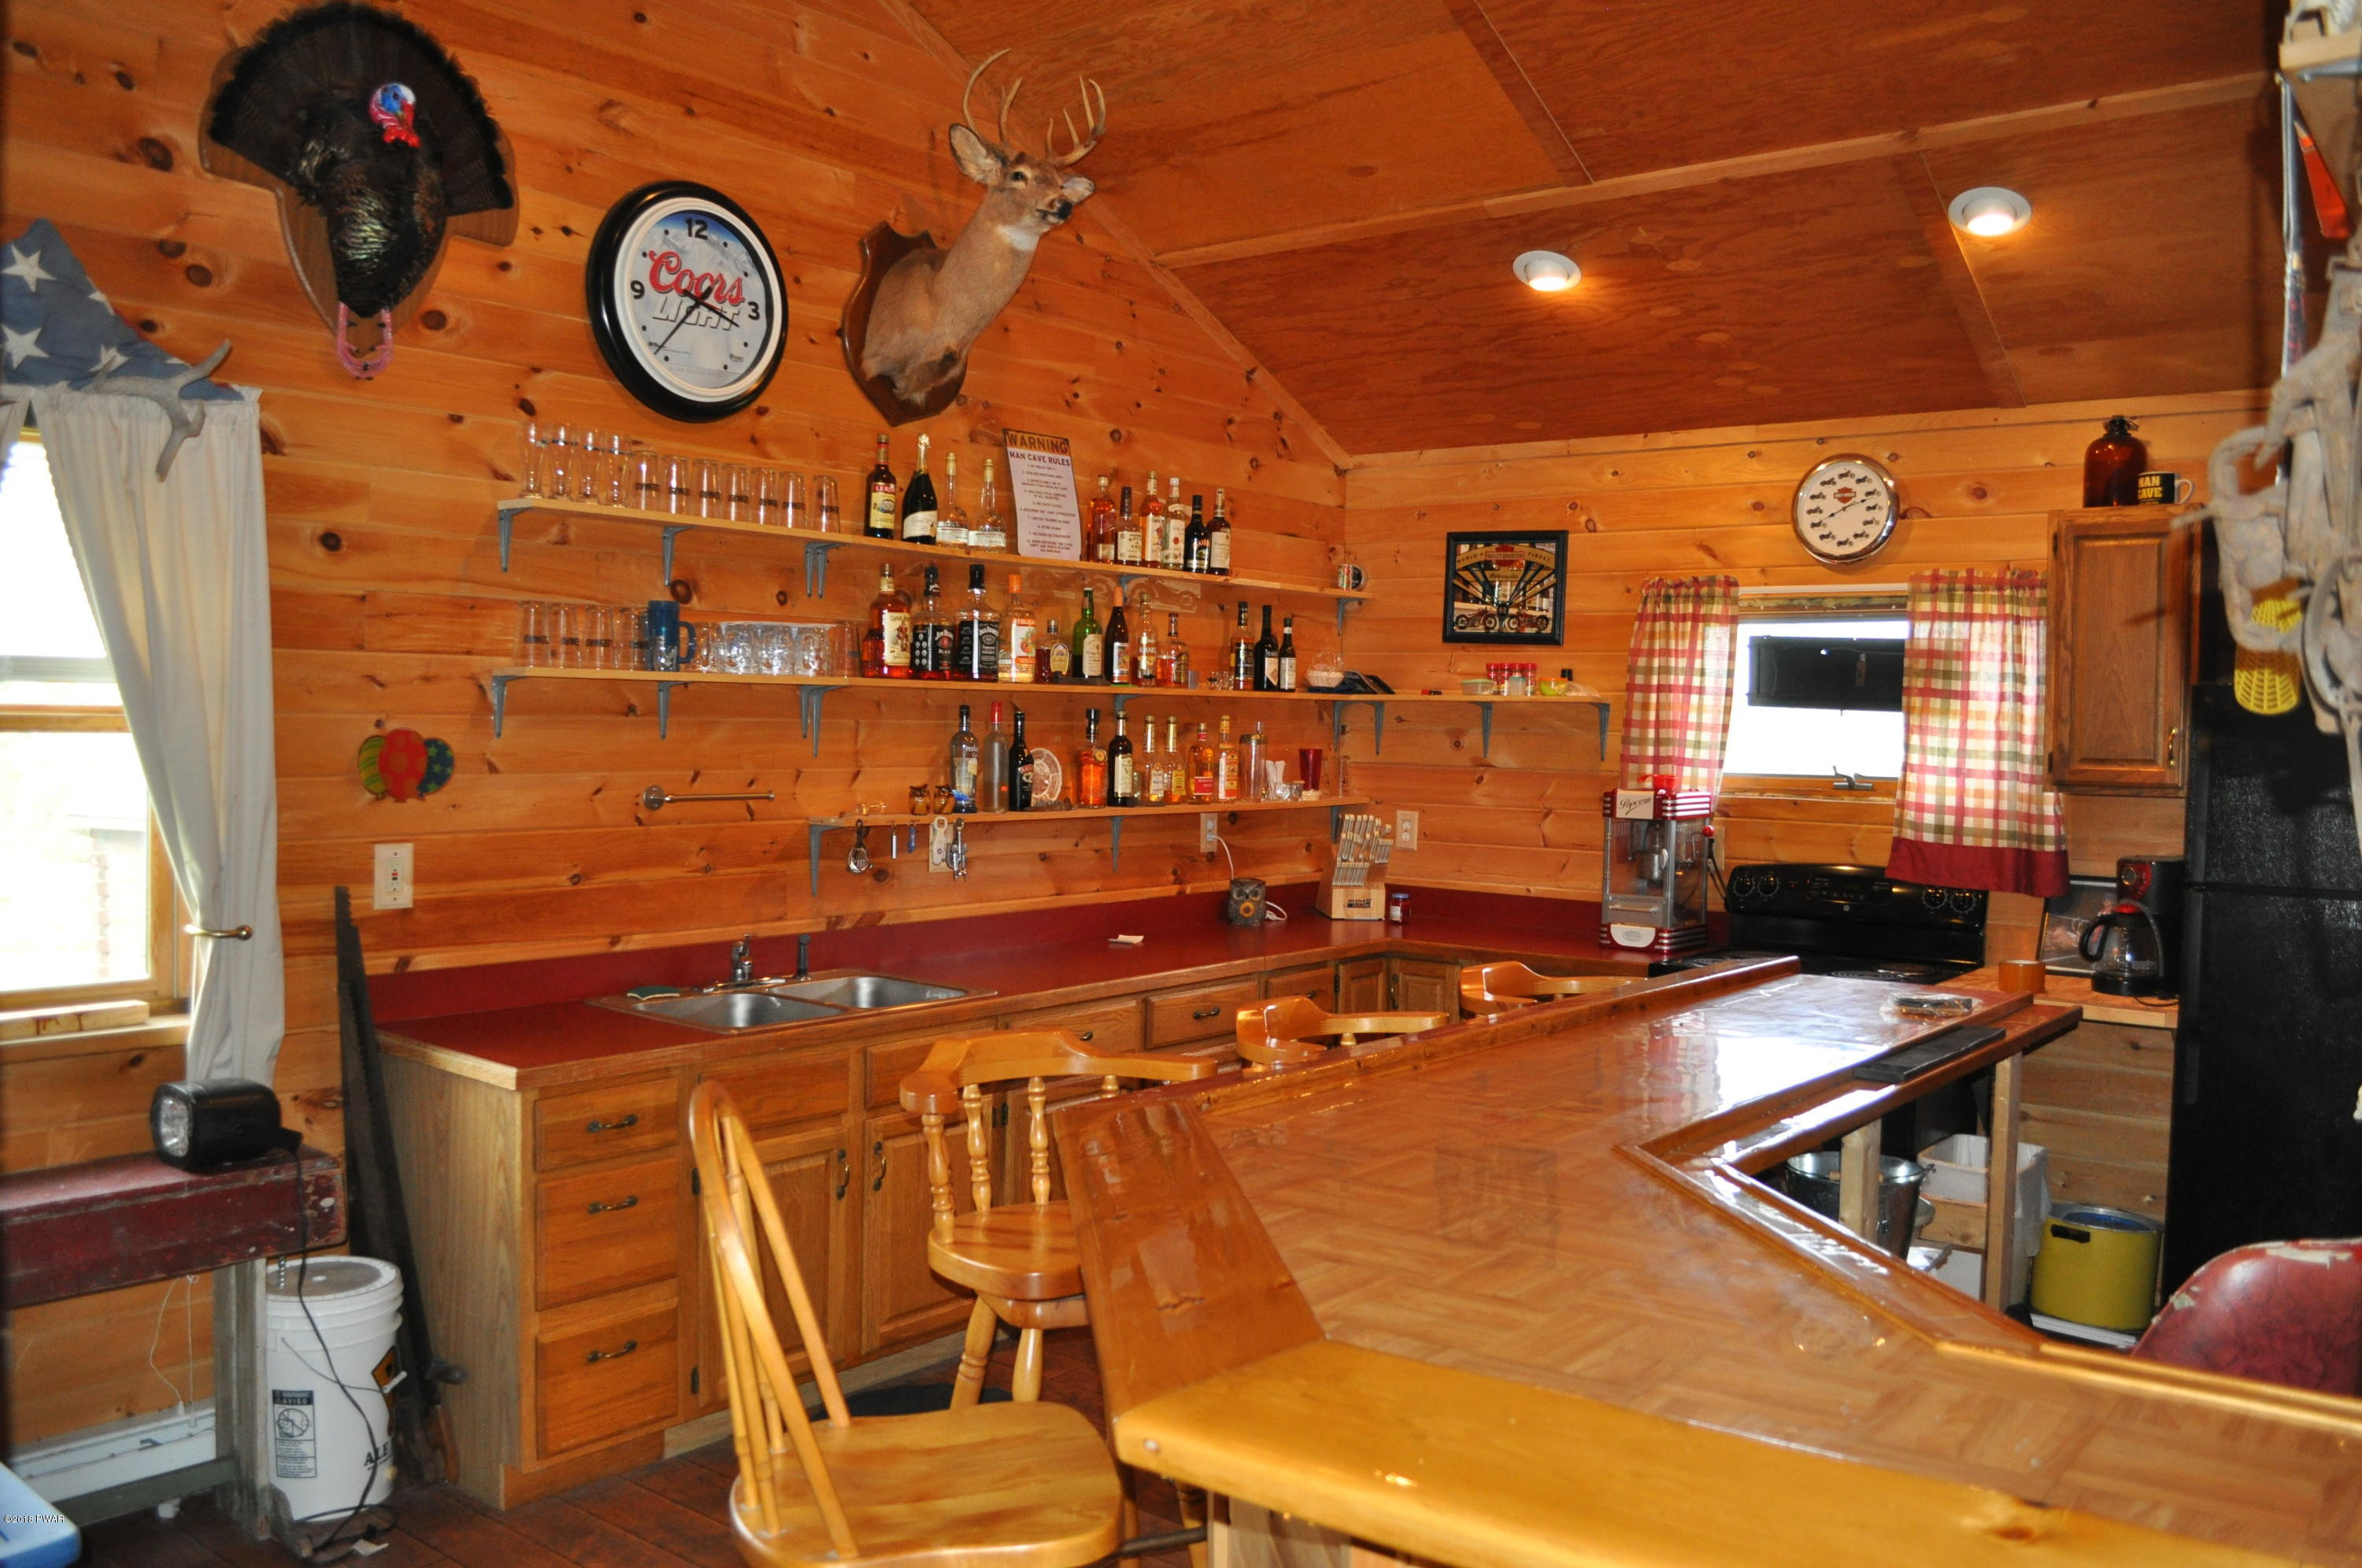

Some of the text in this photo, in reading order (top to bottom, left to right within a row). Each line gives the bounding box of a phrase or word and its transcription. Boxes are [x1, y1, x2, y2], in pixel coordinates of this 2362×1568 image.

[685, 218, 708, 239] 12
[648, 250, 745, 305] Coors
[631, 280, 645, 299] 9
[747, 301, 760, 321] 3
[1009, 434, 1069, 453] WARNING
[1027, 454, 1046, 463] CAVE
[1049, 457, 1071, 467] RULES
[1619, 797, 1651, 815] Popcorn
